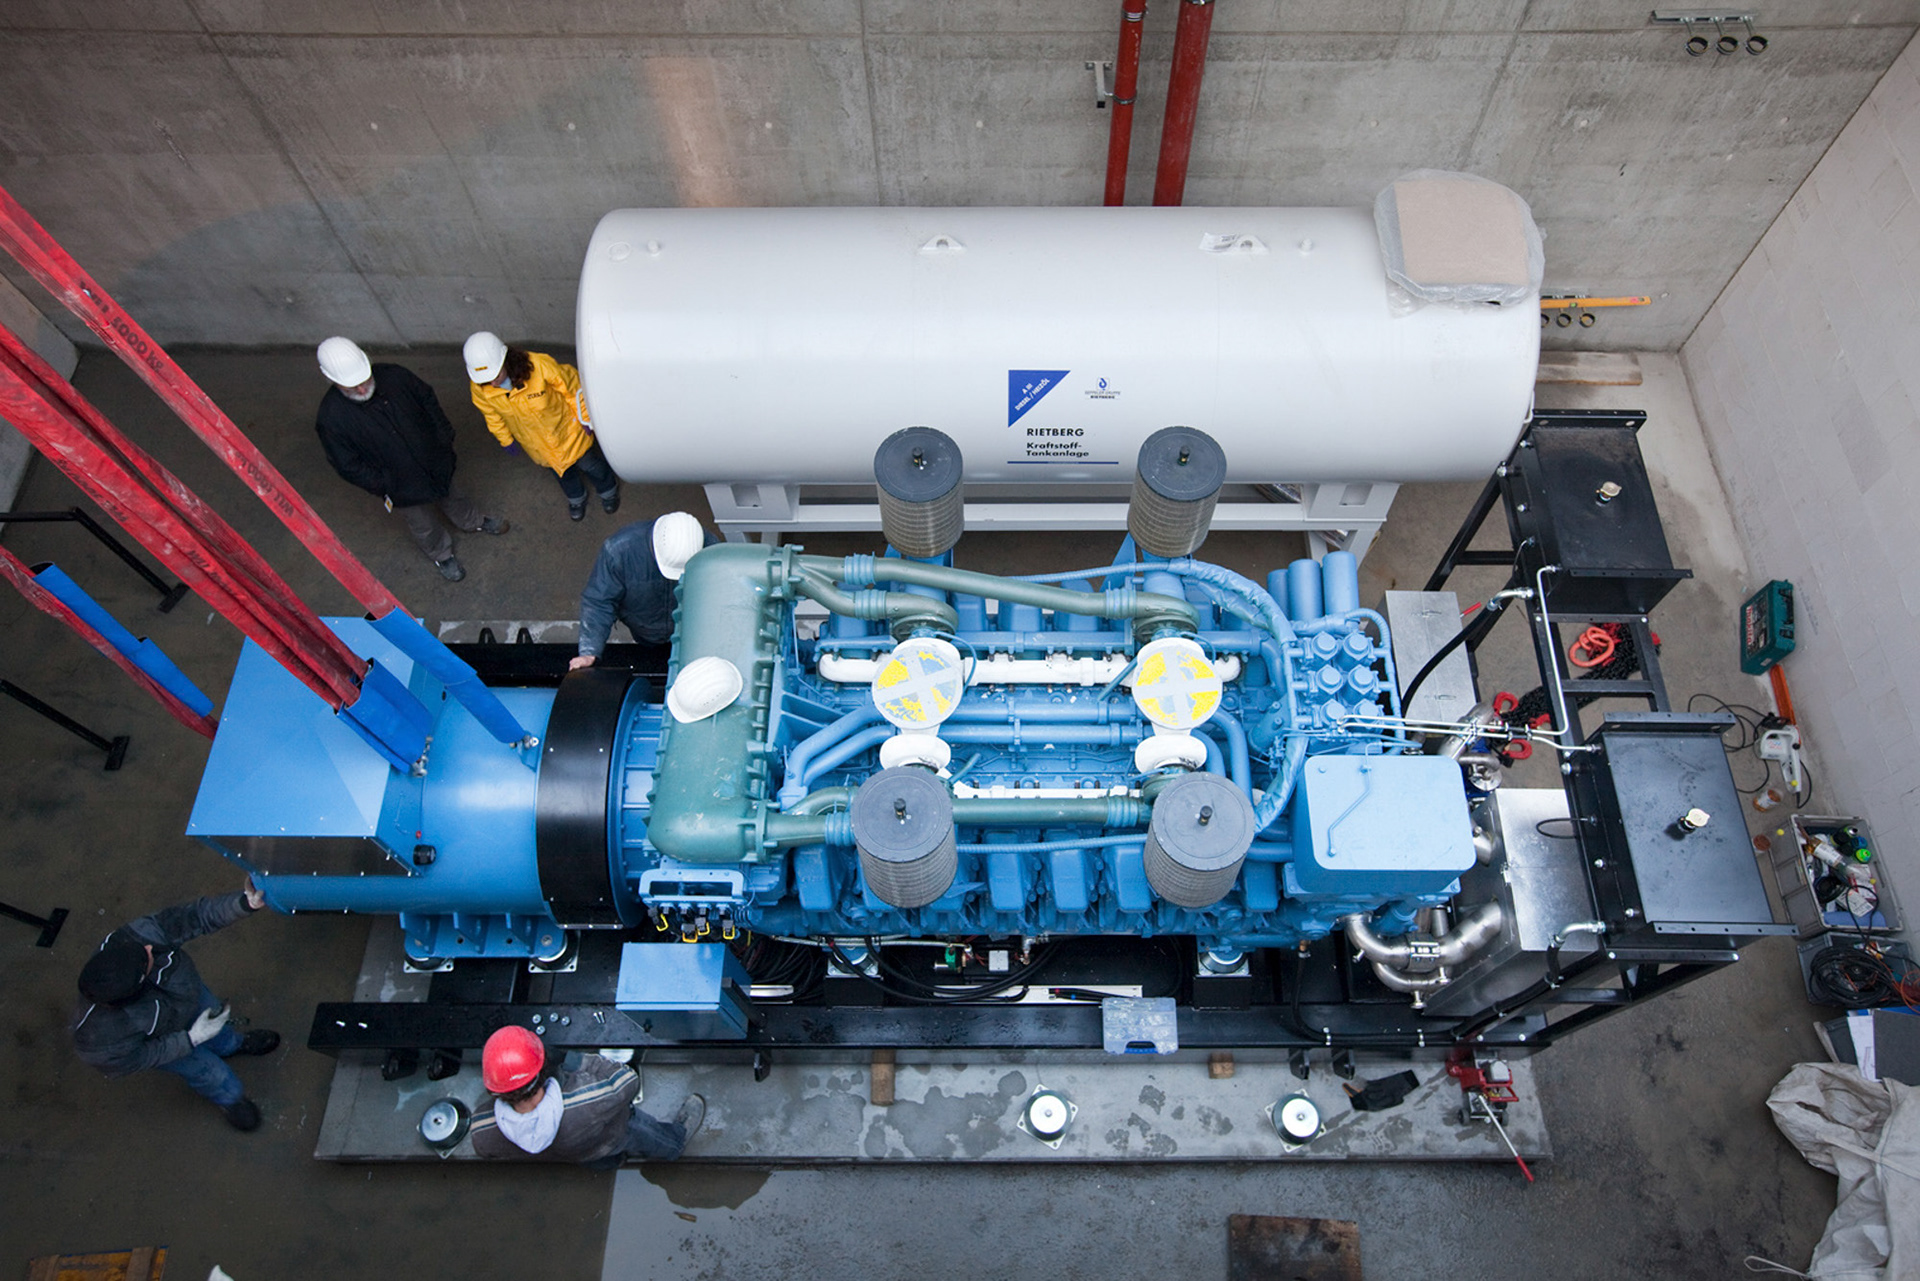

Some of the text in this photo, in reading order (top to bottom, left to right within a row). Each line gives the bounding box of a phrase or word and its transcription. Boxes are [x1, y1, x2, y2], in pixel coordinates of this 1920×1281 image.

[111, 317, 147, 355] 5000
[1015, 396, 1031, 411] DIESEL
[1032, 378, 1050, 395] HEIZÖL
[1026, 428, 1084, 437] RIETBERG
[1026, 441, 1082, 449] Kraftstoff-
[1026, 450, 1089, 458] Tankanlage
[1746, 604, 1754, 645] makita
